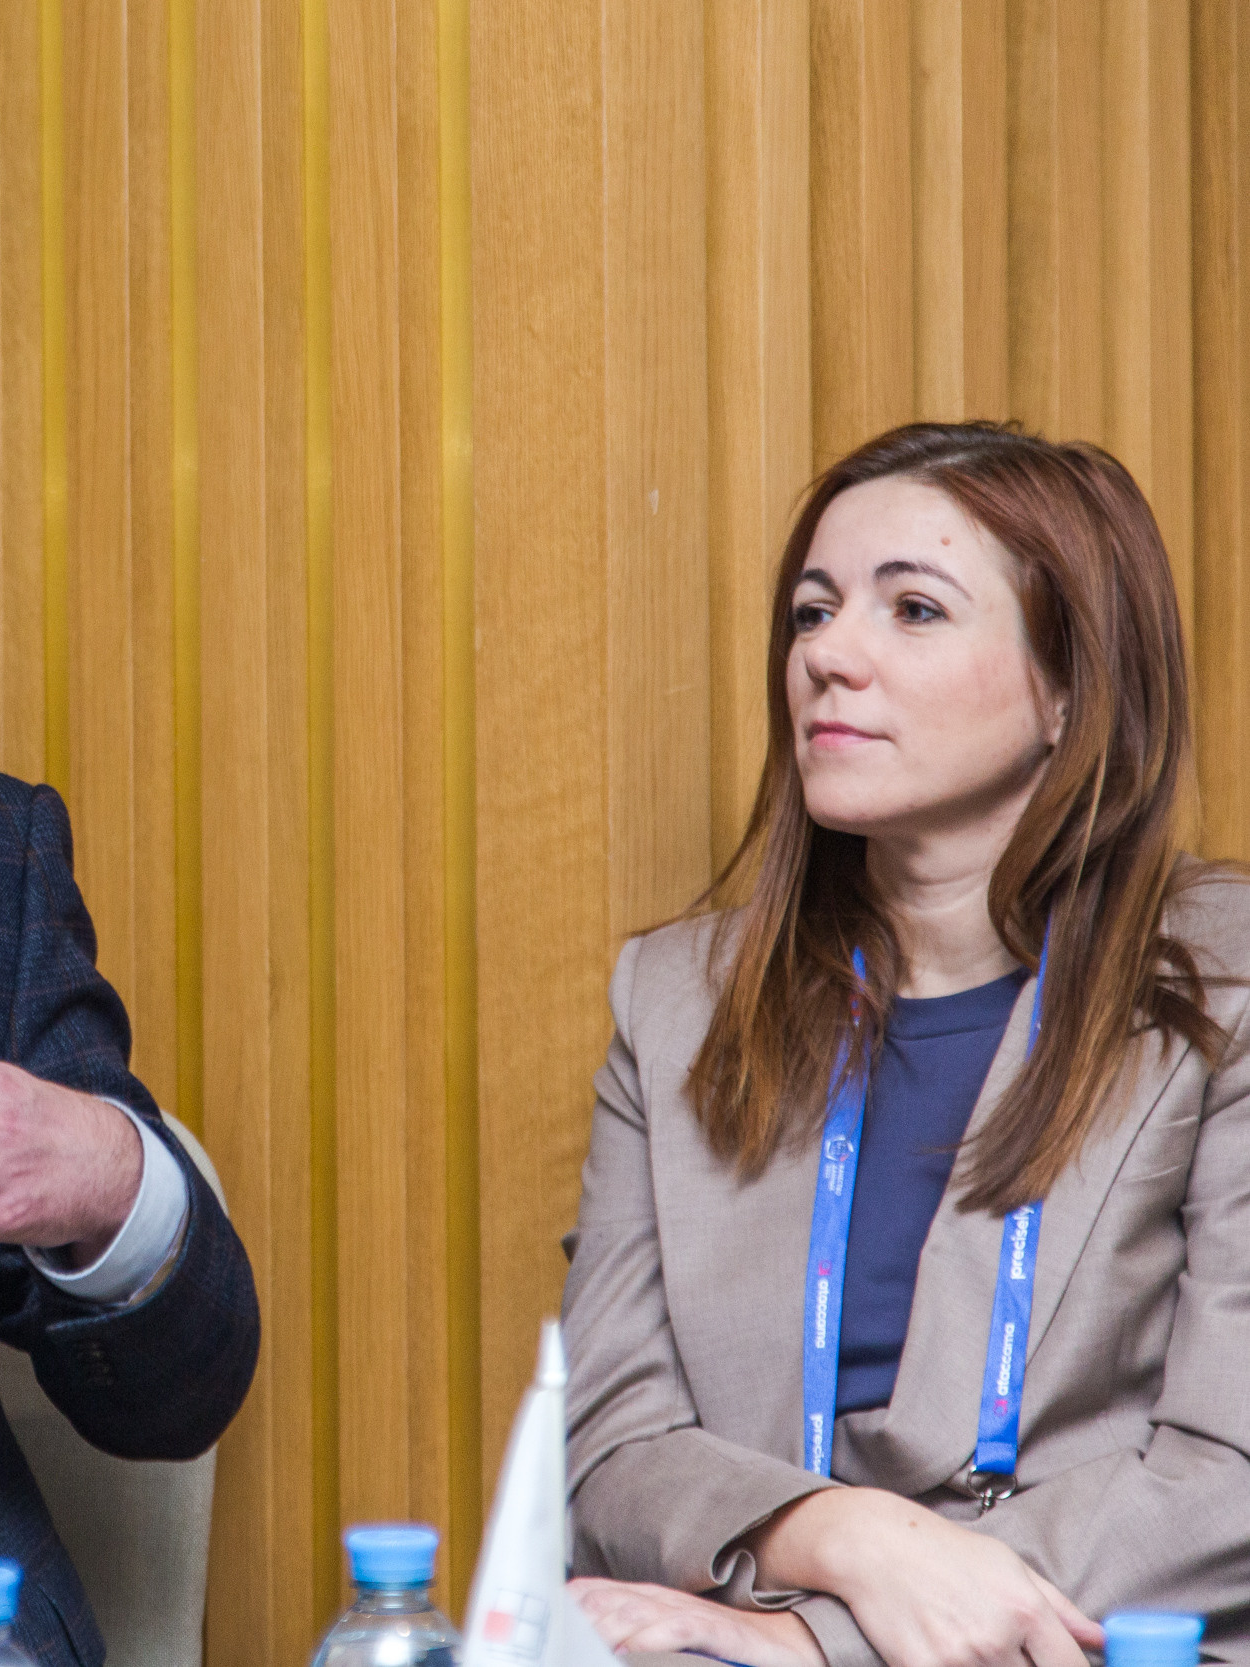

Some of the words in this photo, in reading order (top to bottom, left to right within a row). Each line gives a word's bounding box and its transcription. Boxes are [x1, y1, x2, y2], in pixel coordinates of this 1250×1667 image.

[1010, 1206, 1035, 1280] precisely
[815, 1277, 830, 1349] ataccama
[997, 1322, 1016, 1397] ataccama
